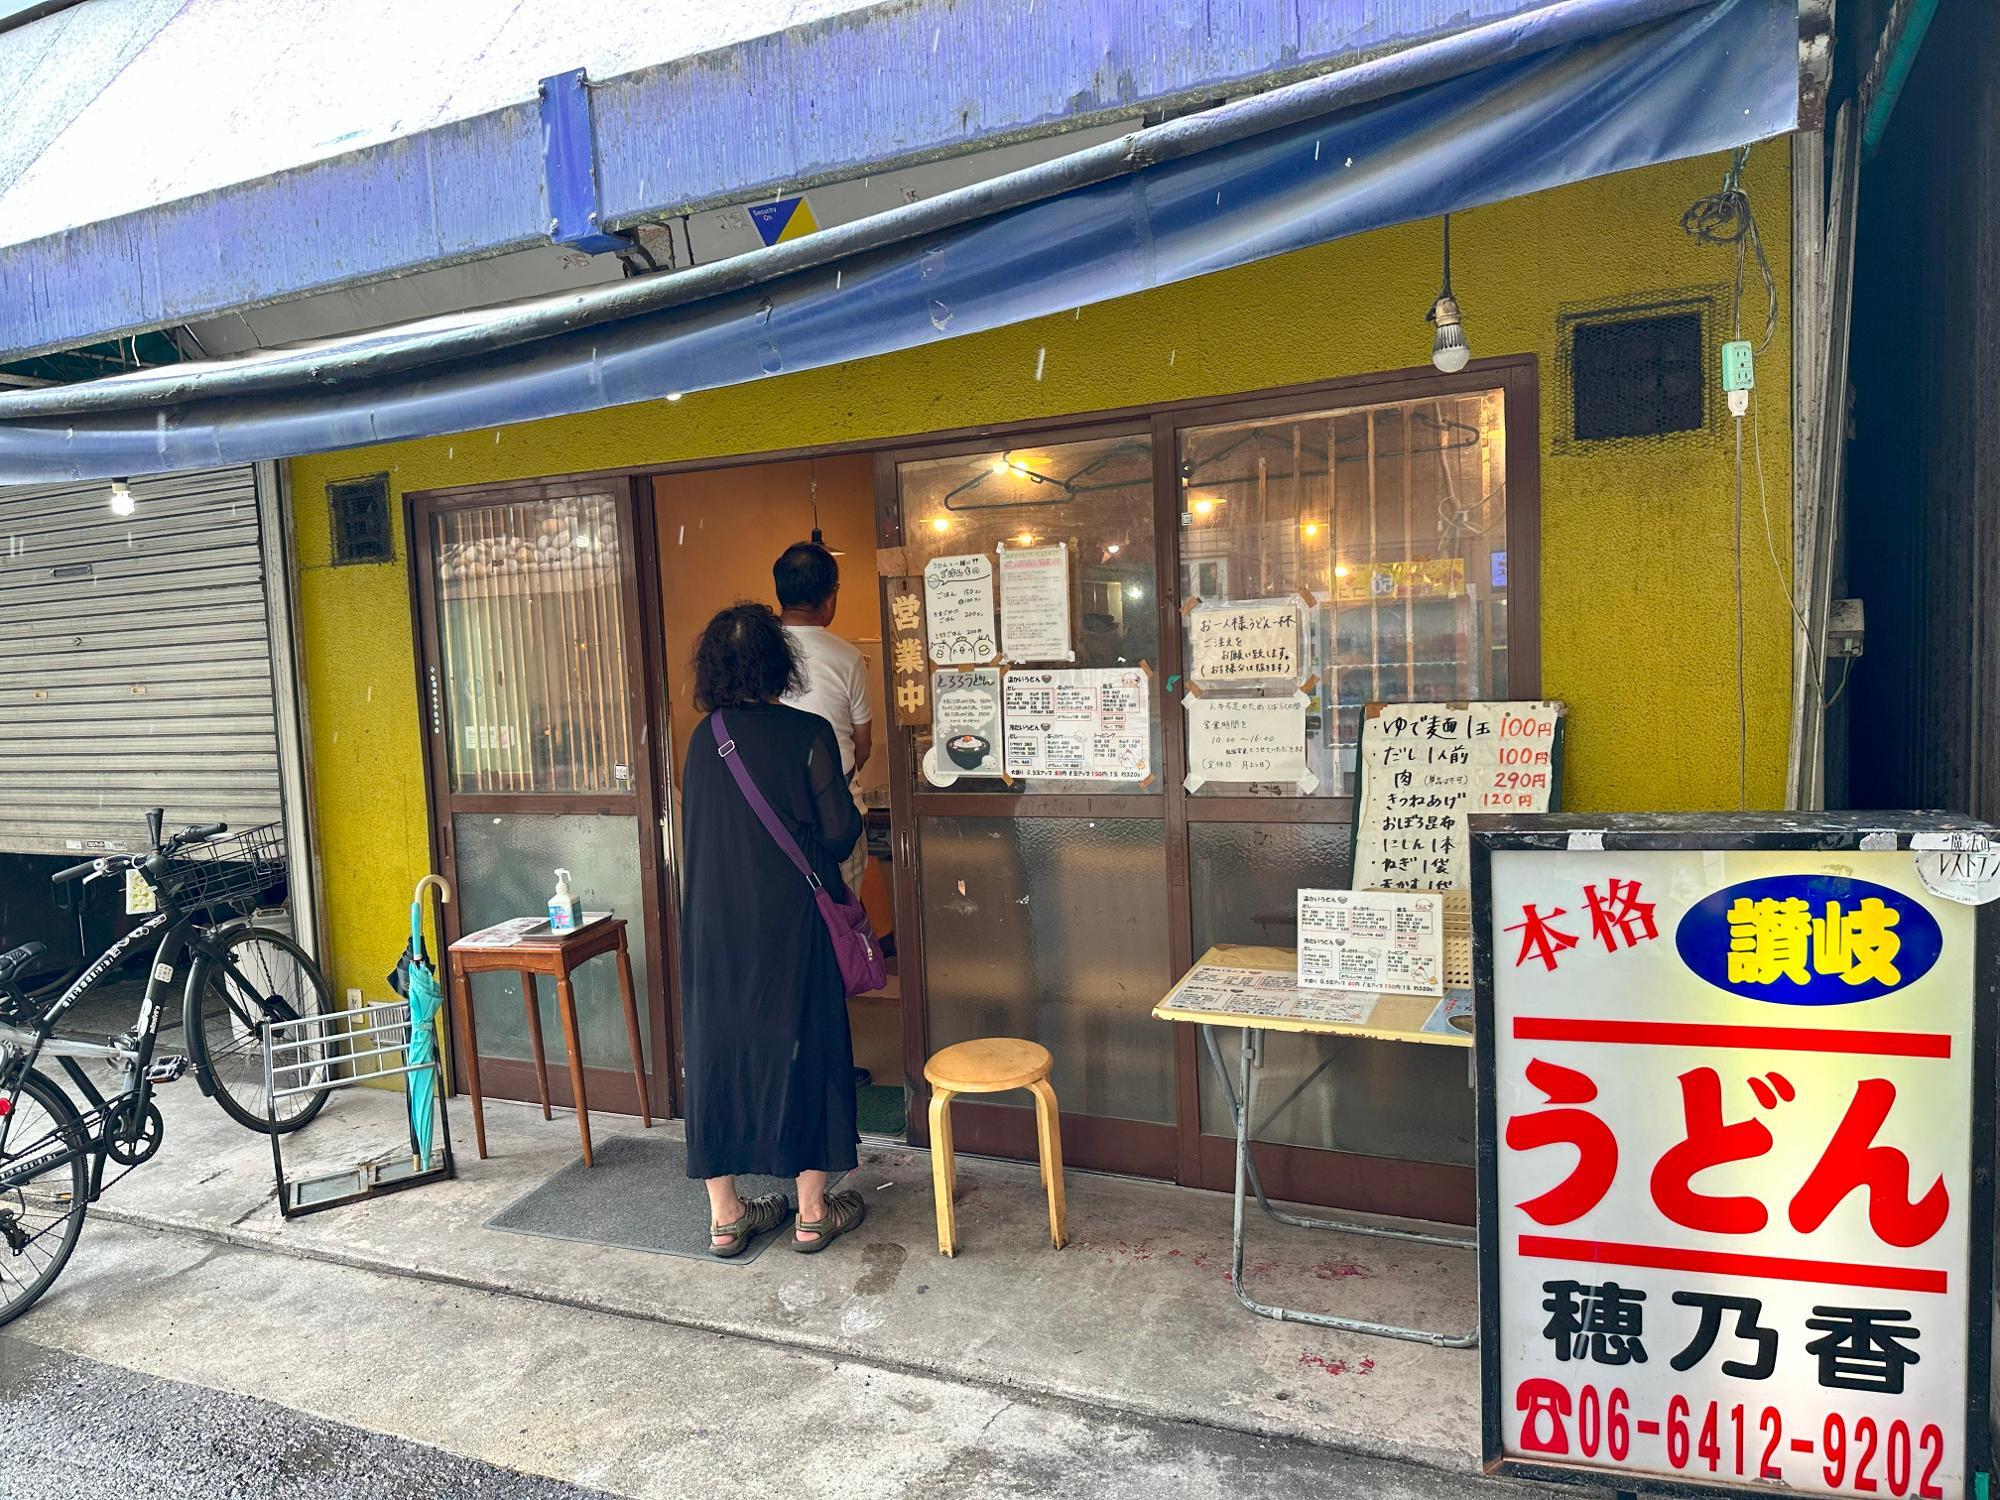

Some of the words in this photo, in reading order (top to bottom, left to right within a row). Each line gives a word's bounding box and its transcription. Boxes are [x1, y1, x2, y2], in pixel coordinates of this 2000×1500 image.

[753, 207, 777, 216] Security
[1200, 615, 1296, 632] お一人様うどん一杯
[1204, 636, 1242, 648] ご注文を
[892, 593, 925, 714] 営業中
[1222, 646, 1289, 661] お願い致します。
[937, 675, 995, 688] とろろうどん
[1384, 716, 1458, 740] ゆで麺
[1500, 718, 1551, 737] 100円
[1384, 746, 1416, 765] だし
[1429, 745, 1469, 764] 1人前
[1499, 748, 1549, 765] 100円
[1395, 769, 1412, 788] 肉
[1494, 772, 1546, 789] 290円
[1386, 792, 1466, 811] きつねあげ
[1483, 794, 1533, 807] 120円
[1383, 814, 1456, 832] おぼろ昆布
[1383, 838, 1424, 852] にしん
[1431, 837, 1457, 854] 1本
[1382, 857, 1417, 872] ねぎ
[1423, 858, 1450, 874] 1袋
[1504, 878, 1659, 972] 本格
[1727, 897, 1901, 986] 讃岐
[1505, 1057, 1950, 1248] うどん
[1542, 1279, 1921, 1395] 穂乃香
[1578, 1384, 1944, 1498] 06-6412-9202
